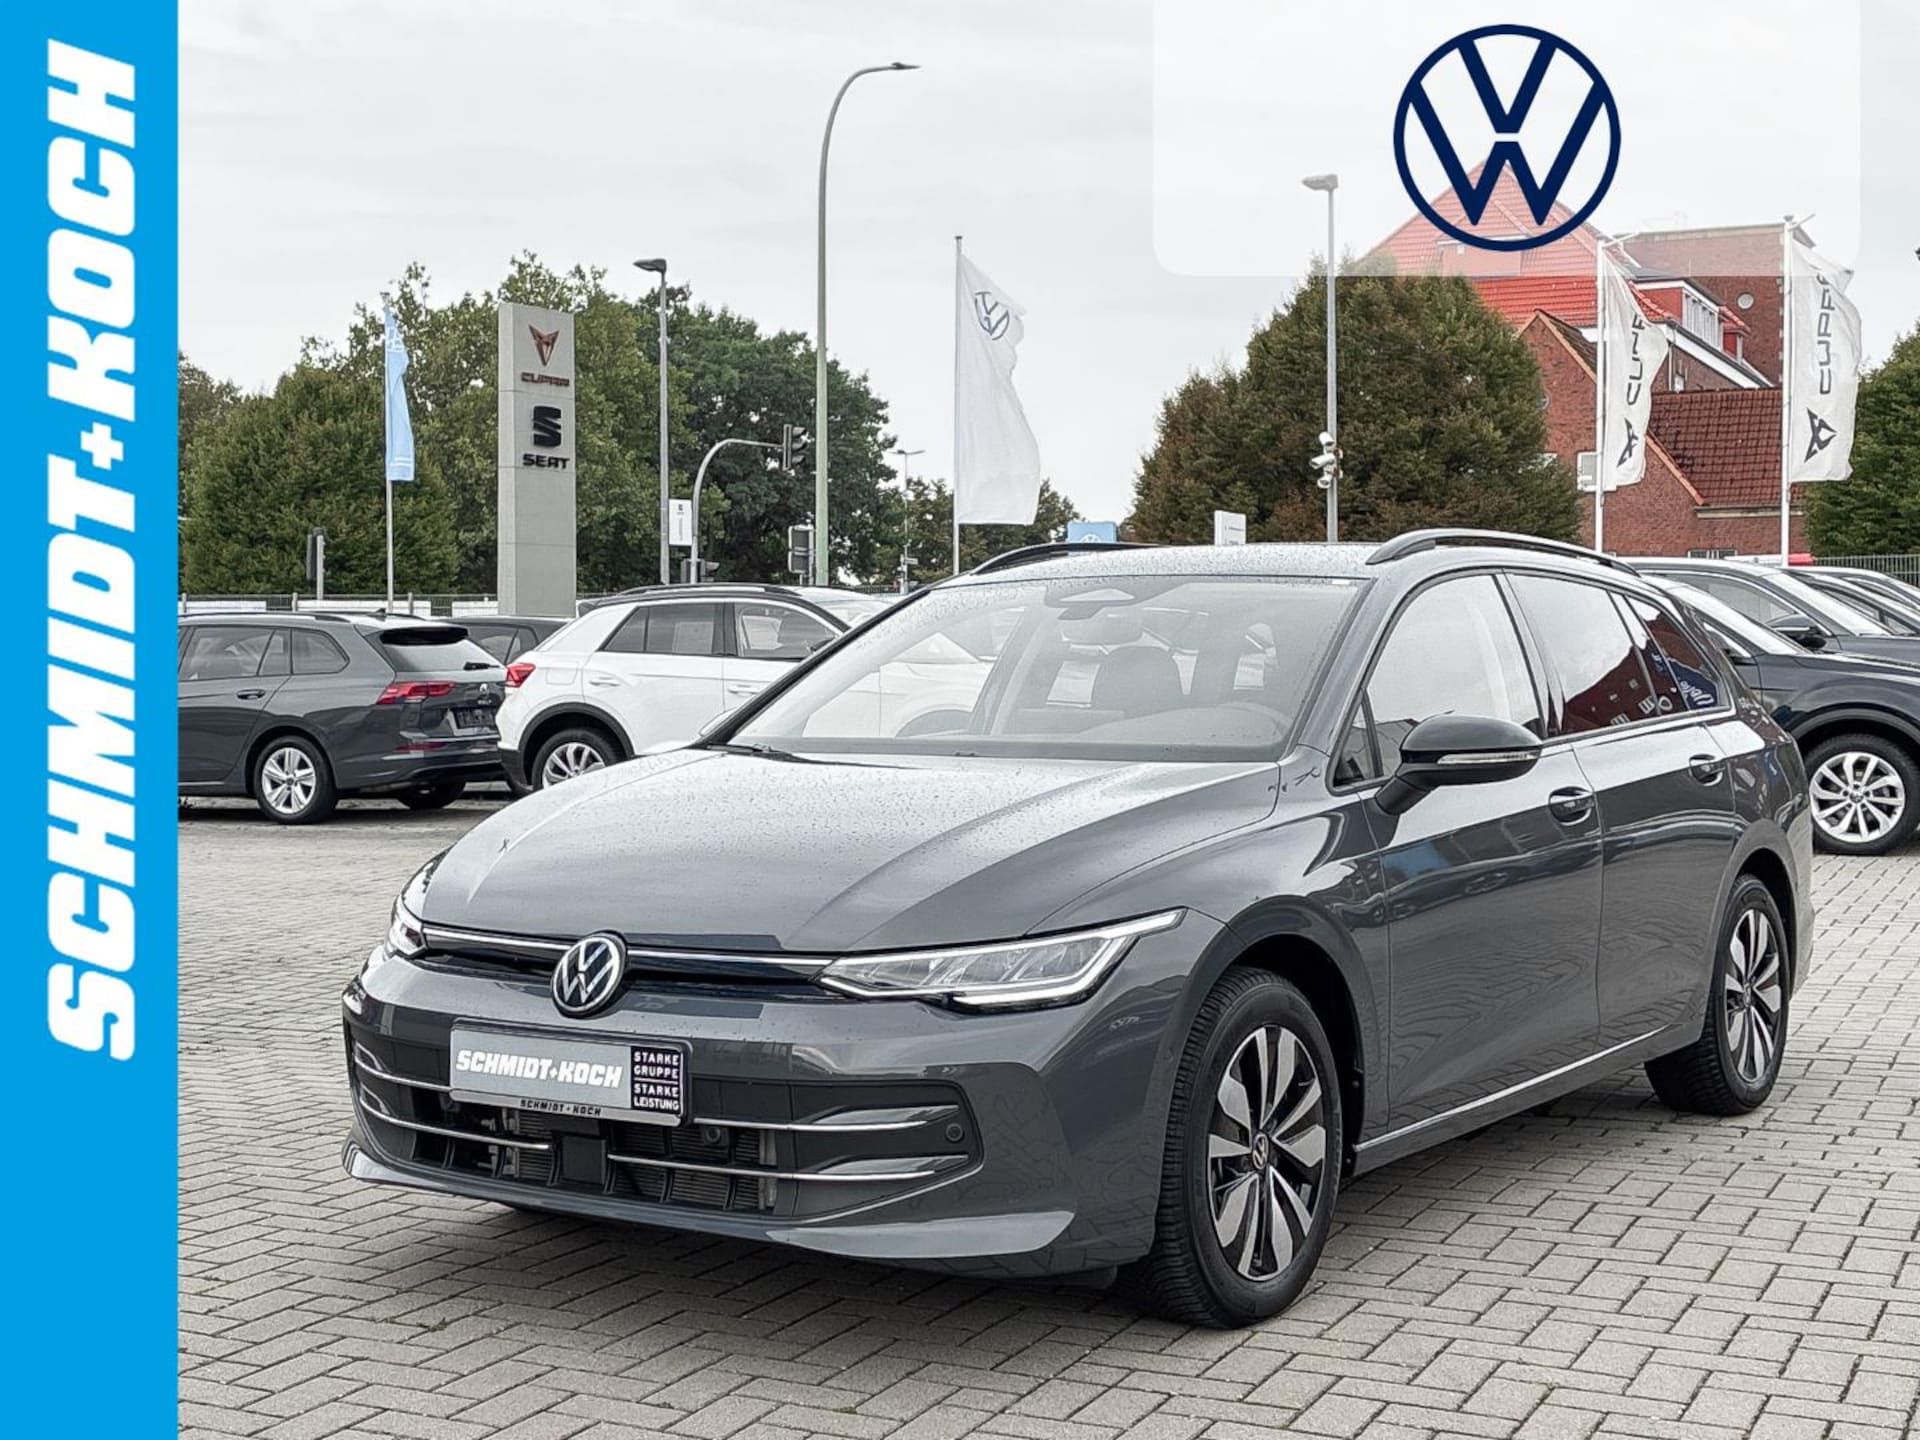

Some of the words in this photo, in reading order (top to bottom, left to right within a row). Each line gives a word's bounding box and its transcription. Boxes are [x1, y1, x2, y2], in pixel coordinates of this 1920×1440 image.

[522, 453, 571, 470] SEAT
[633, 1051, 680, 1066] STARKE
[456, 1049, 624, 1089] SCHMIDT+KOCH
[633, 1064, 679, 1079] GRUPPE
[633, 1083, 680, 1097] STARKE
[520, 1099, 565, 1113] SCHMIDT
[573, 1105, 602, 1117] KOCH
[633, 1096, 681, 1111] LEISTUNG
